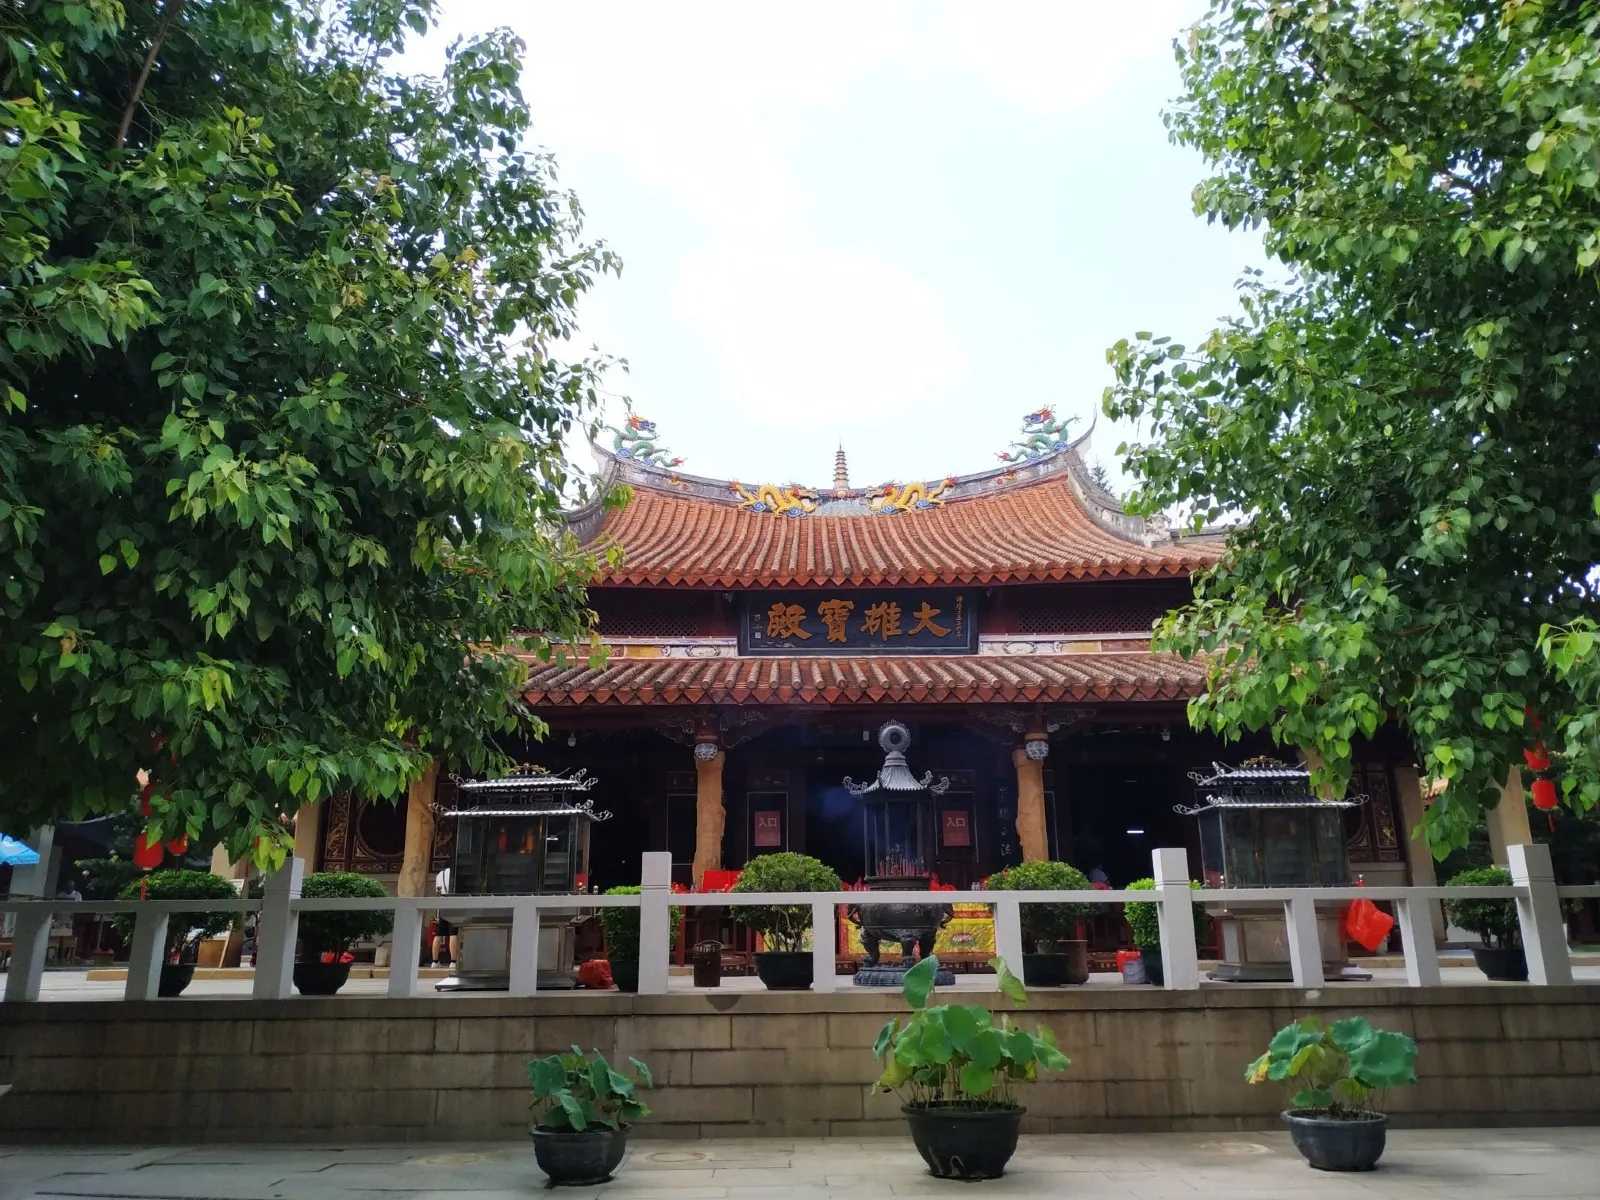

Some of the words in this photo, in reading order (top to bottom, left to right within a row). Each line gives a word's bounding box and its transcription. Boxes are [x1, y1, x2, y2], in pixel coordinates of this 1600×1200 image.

[767, 598, 952, 643] 大雄寶殿
[758, 817, 778, 828] 入口
[946, 817, 966, 827] 入口
